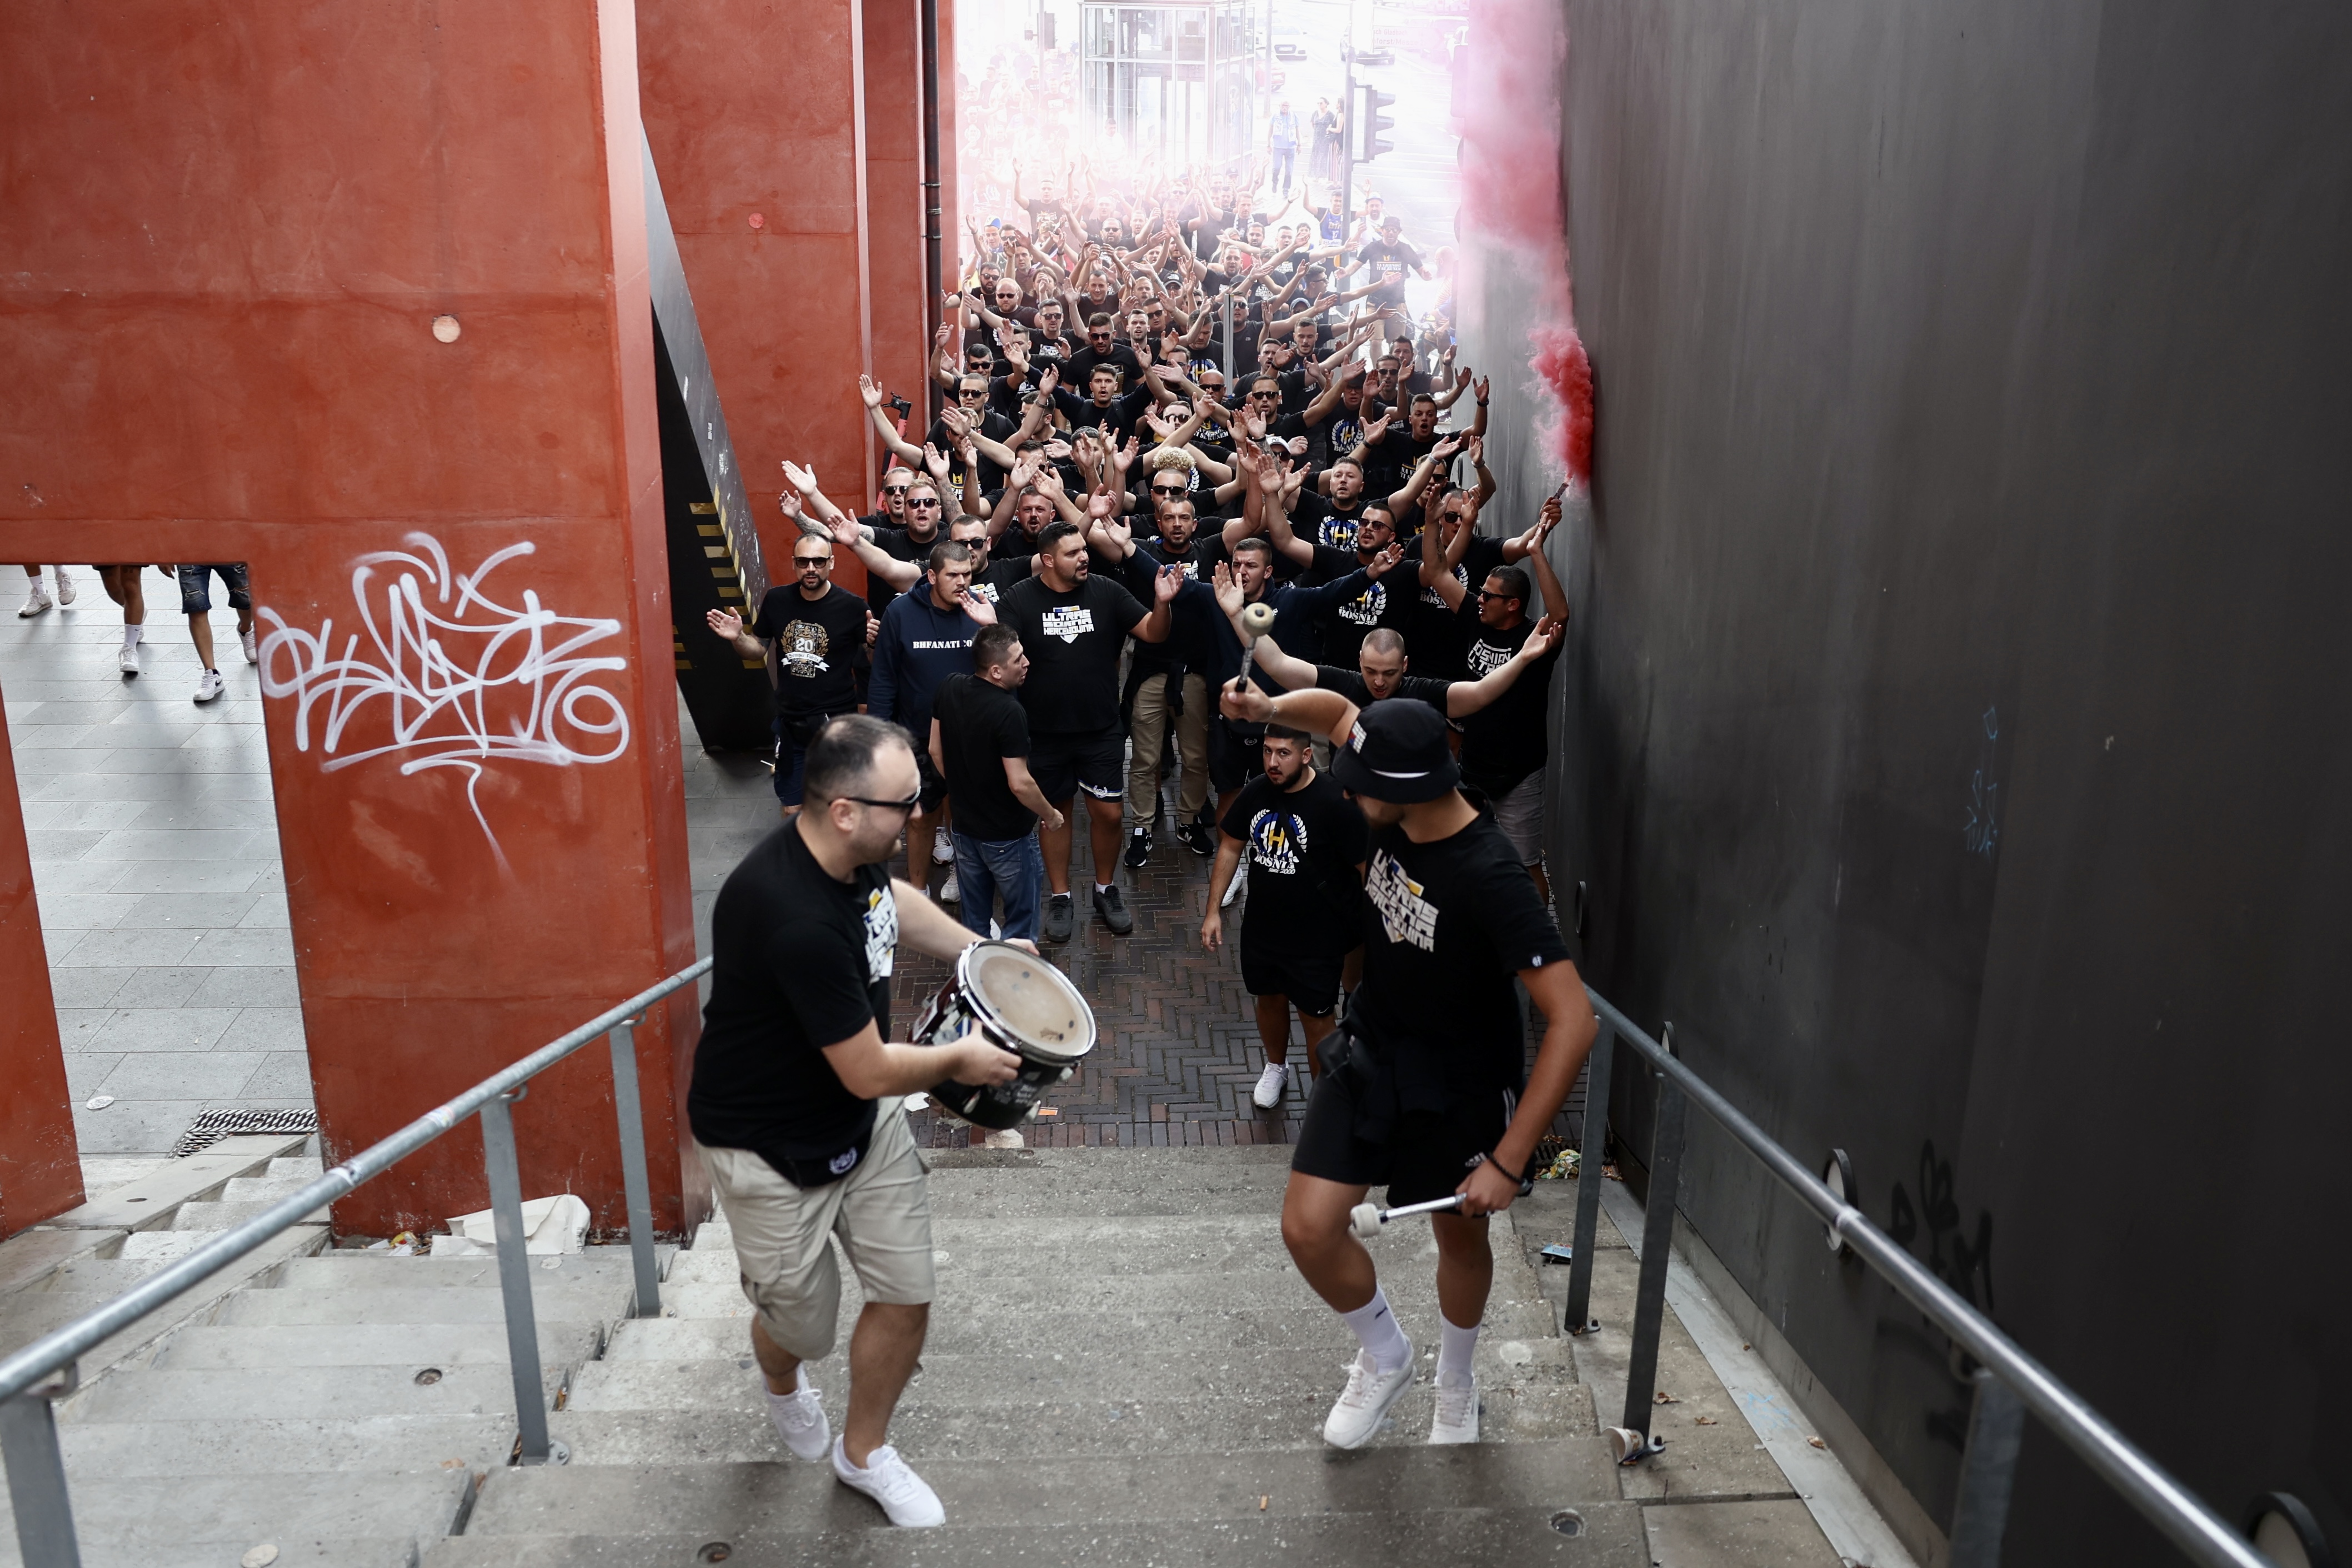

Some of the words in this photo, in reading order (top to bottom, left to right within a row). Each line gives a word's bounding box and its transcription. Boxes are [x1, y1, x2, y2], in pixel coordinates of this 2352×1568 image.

[1420, 594, 1447, 605] BOSN
[1042, 609, 1091, 621] ULTRAS
[1339, 609, 1377, 622] BOSNIA
[796, 638, 813, 652] 20
